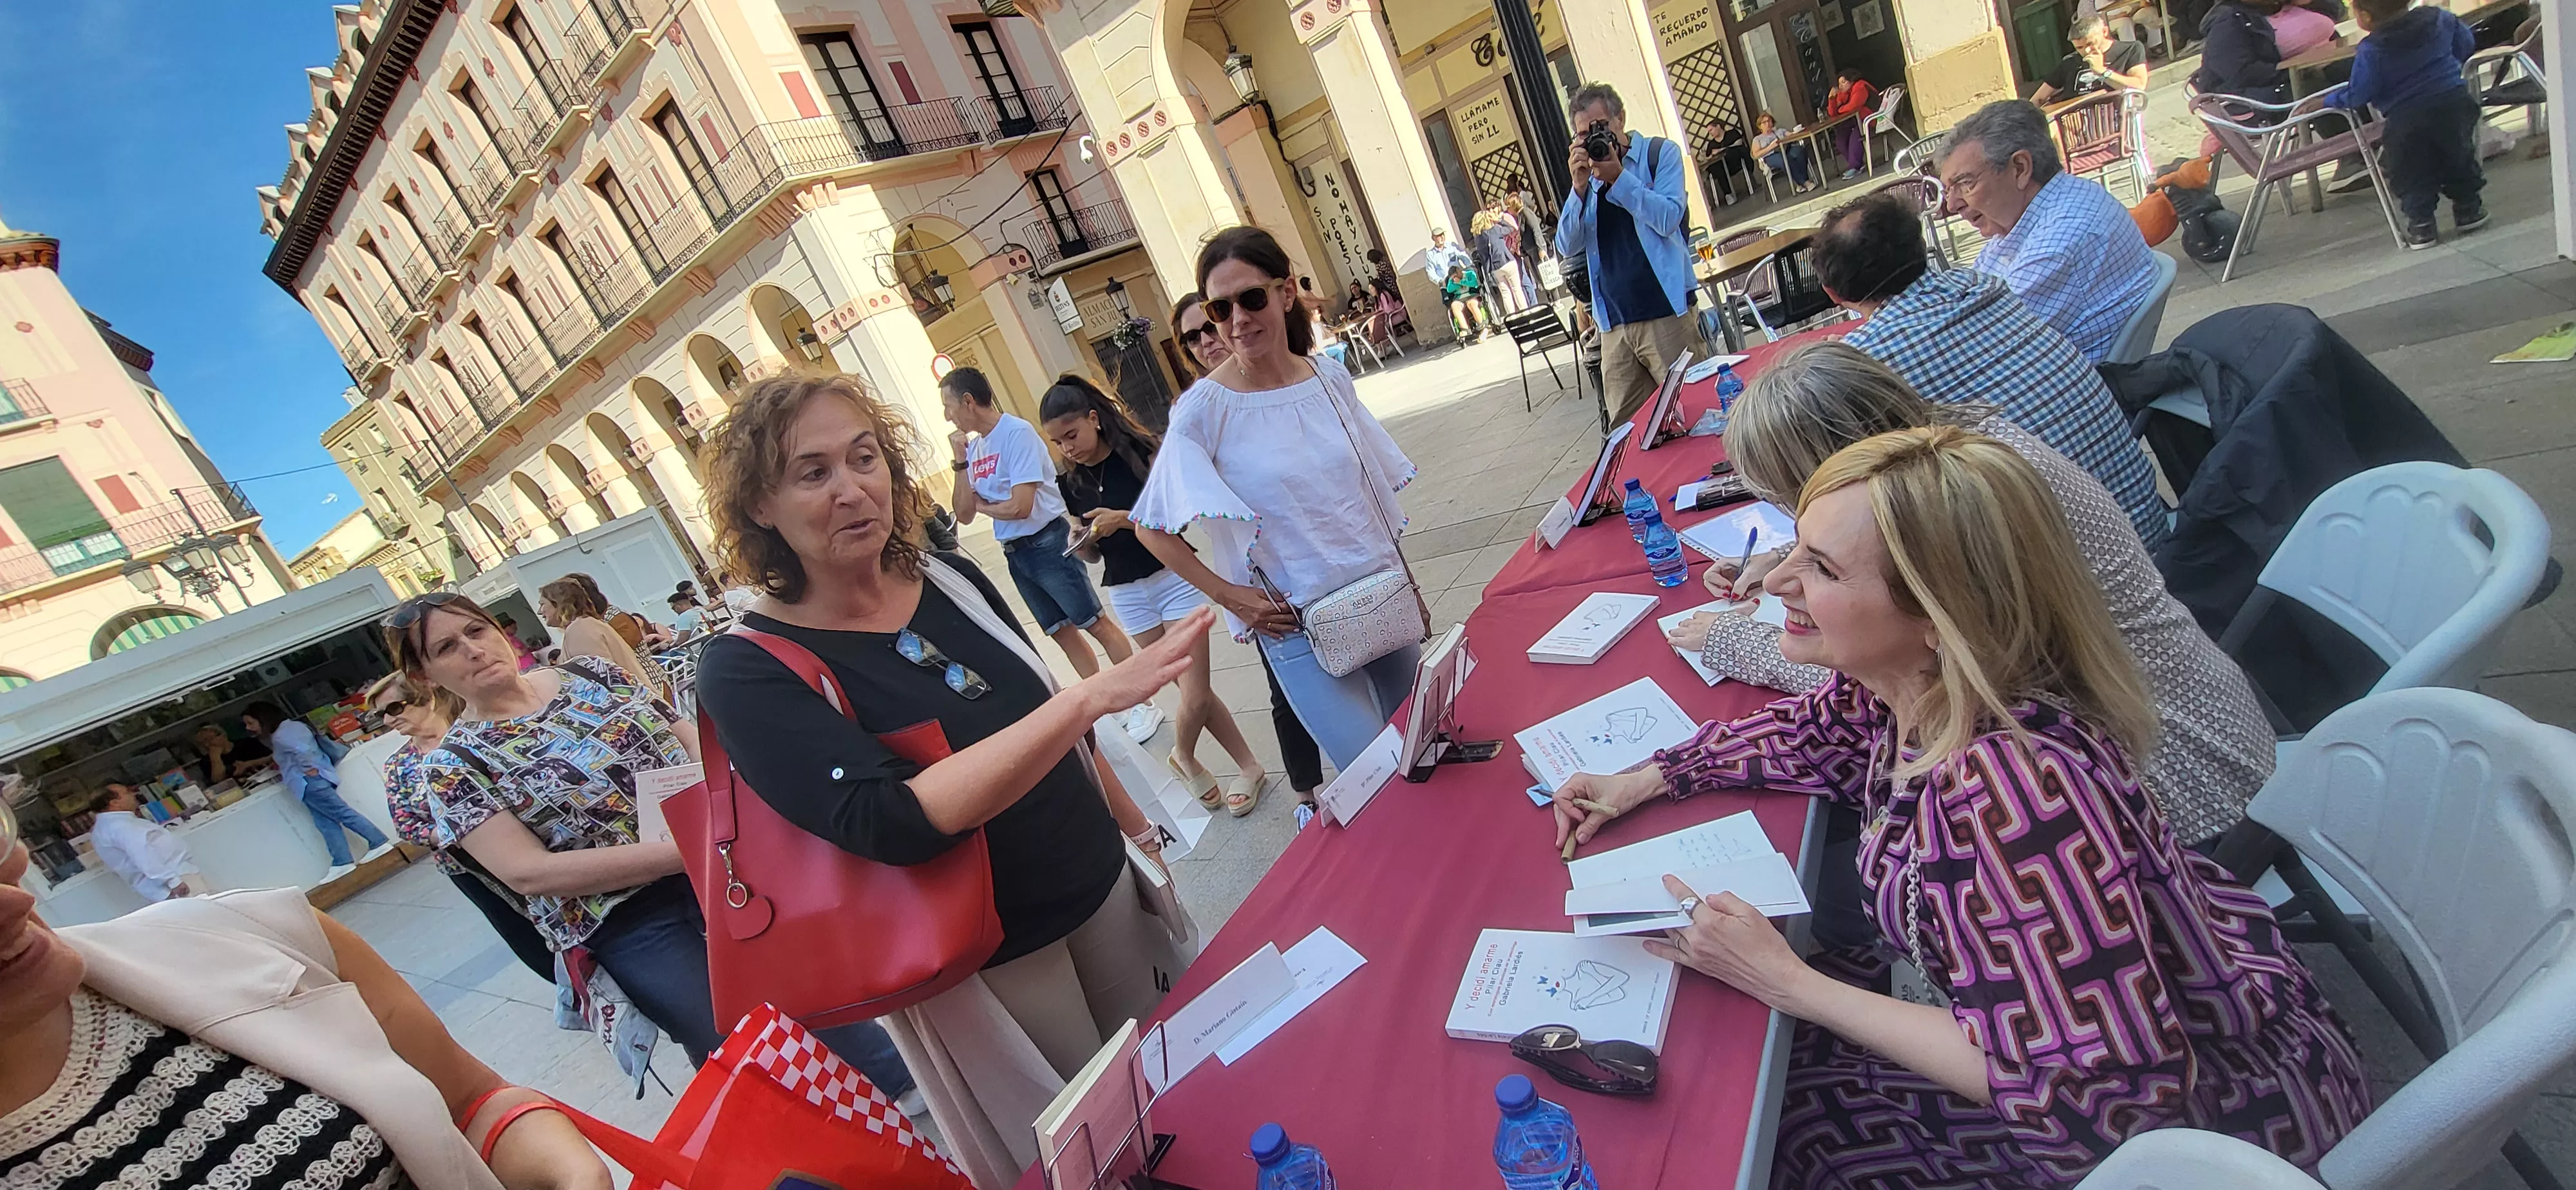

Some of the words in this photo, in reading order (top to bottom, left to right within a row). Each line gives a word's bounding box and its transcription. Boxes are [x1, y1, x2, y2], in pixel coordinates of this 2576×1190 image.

[1653, 12, 1667, 24] TE
[1660, 7, 1709, 36] RECUERDO
[1665, 21, 1708, 47] AMANDO
[1461, 97, 1500, 123] LLÁMAME
[1468, 117, 1488, 133] PERO
[1472, 132, 1484, 145] SIN
[1486, 125, 1500, 138] LL
[1313, 206, 1332, 244] SIN
[1325, 172, 1340, 198] NO
[1339, 200, 1356, 240] HAY
[1354, 245, 1374, 283] CIUD
[1083, 298, 1115, 319] ALMACE
[1090, 312, 1108, 329] SAN
[1107, 309, 1123, 323] JUA
[1157, 824, 1178, 849] A
[1481, 943, 1498, 974] amarme
[1485, 977, 1496, 995] Pilar
[1492, 958, 1503, 976] Clau
[1499, 976, 1515, 1006] Gabriela
[1509, 950, 1524, 975] Lardiés
[1193, 1036, 1202, 1046] D.
[1200, 1016, 1226, 1041] Mariano
